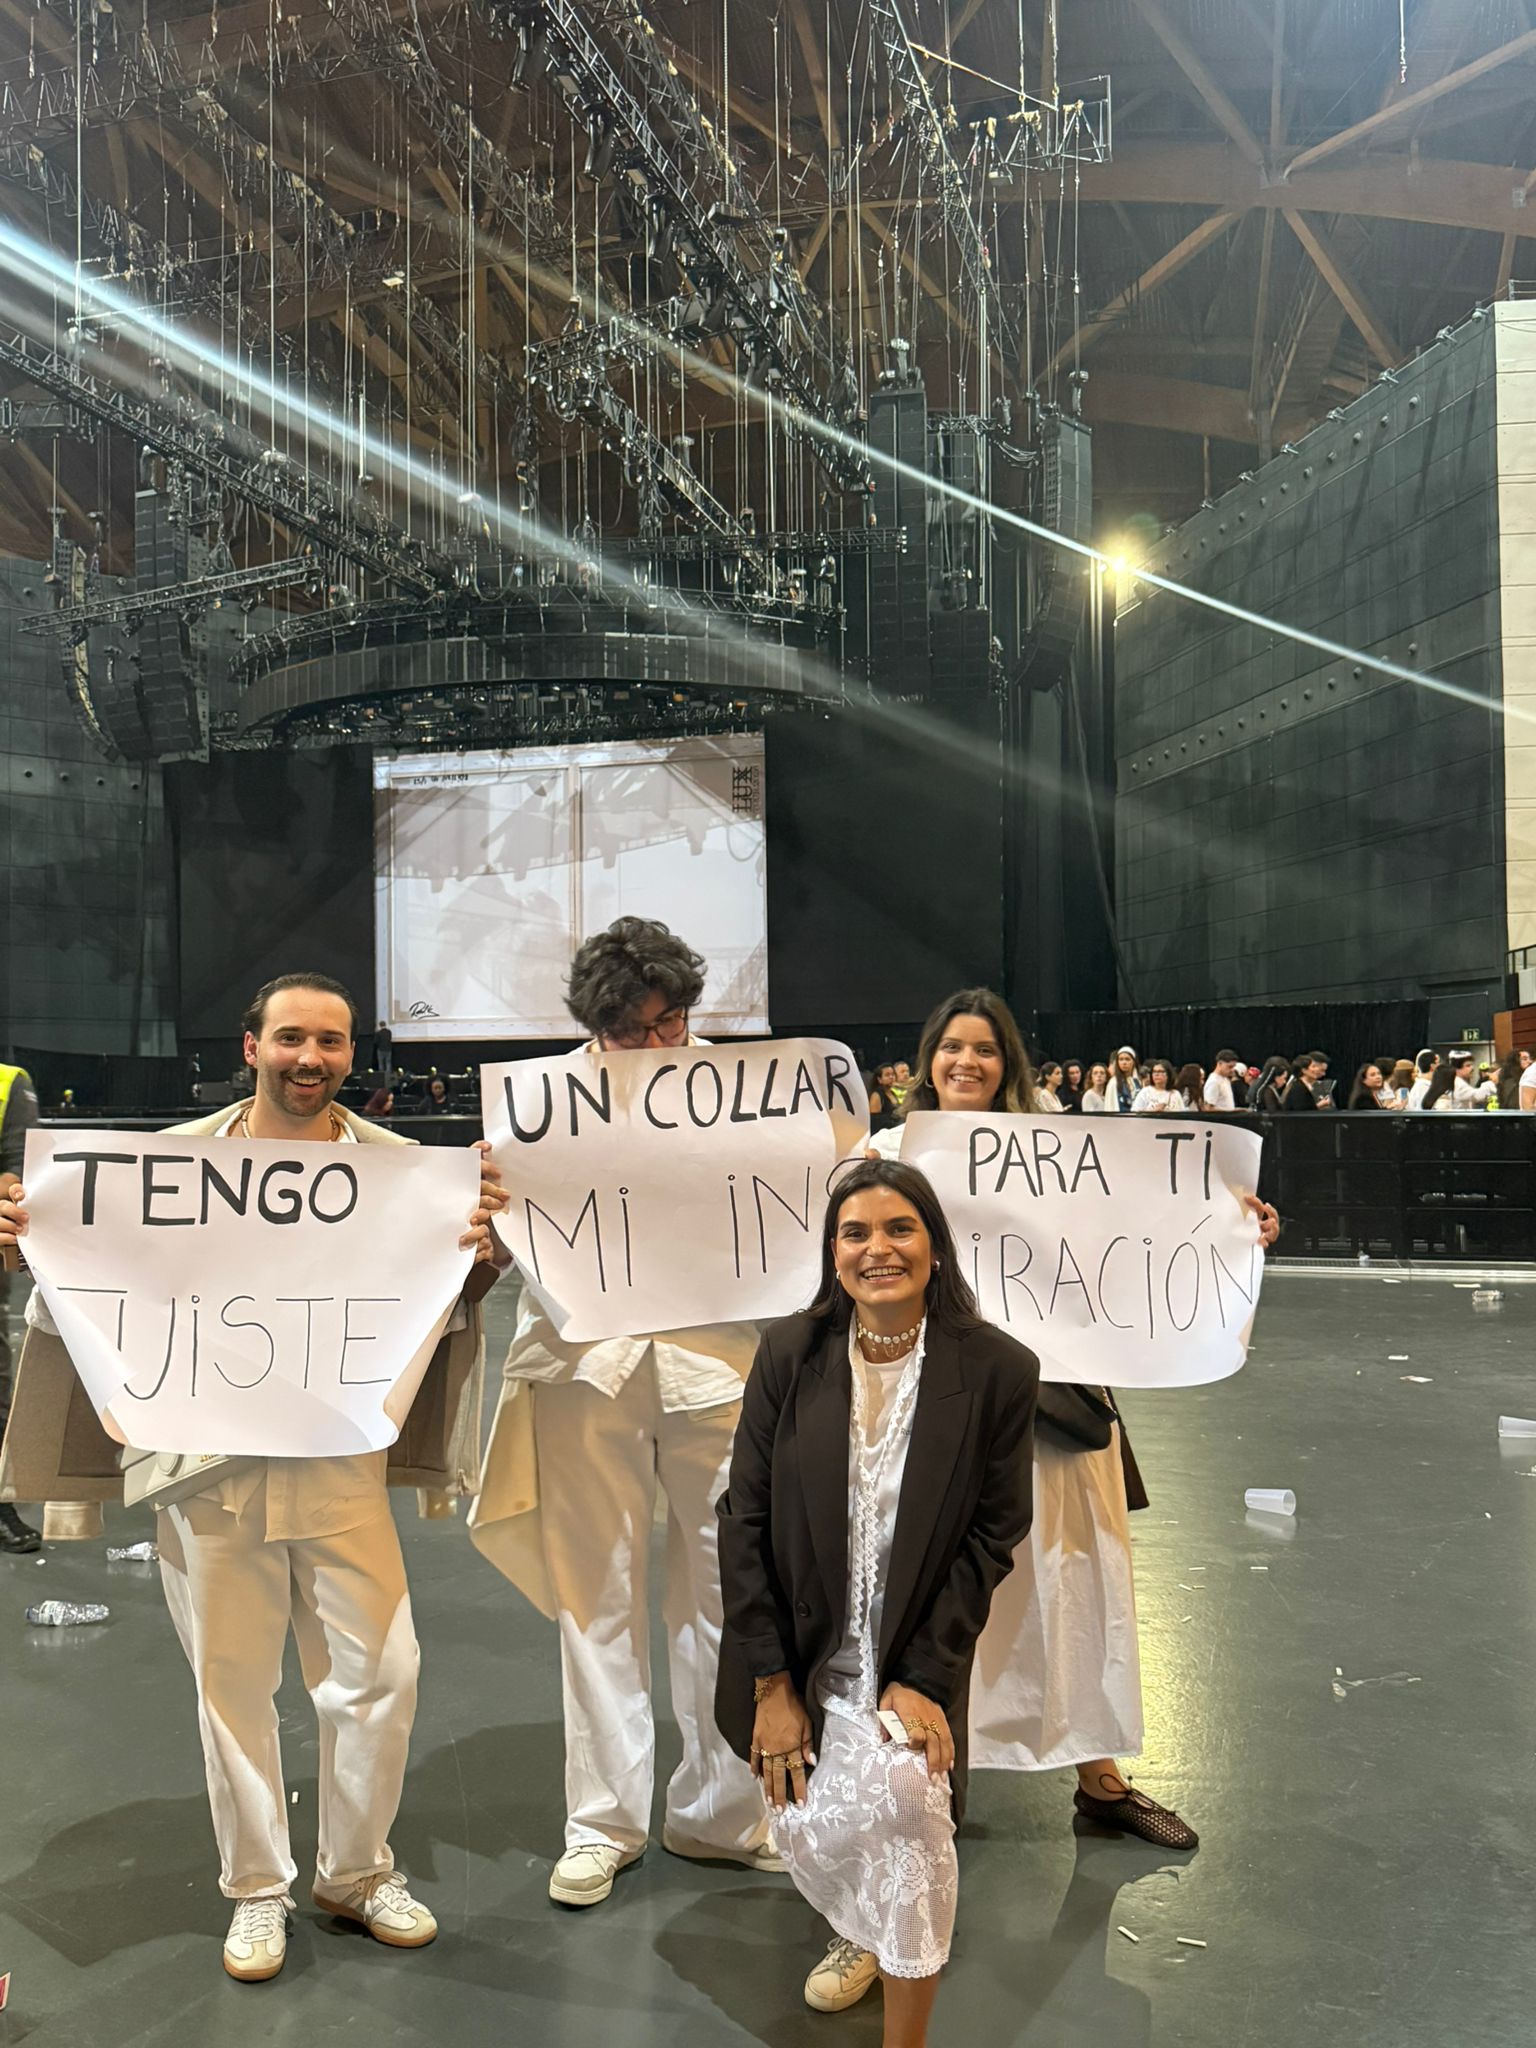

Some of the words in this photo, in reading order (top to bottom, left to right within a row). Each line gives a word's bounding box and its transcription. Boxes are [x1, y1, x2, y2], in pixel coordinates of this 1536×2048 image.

[732, 766, 753, 814] LUX
[503, 1066, 611, 1143] UN
[643, 1055, 855, 1130] COLLAR
[52, 1151, 358, 1226] TENGO
[969, 1127, 1111, 1198] PARA
